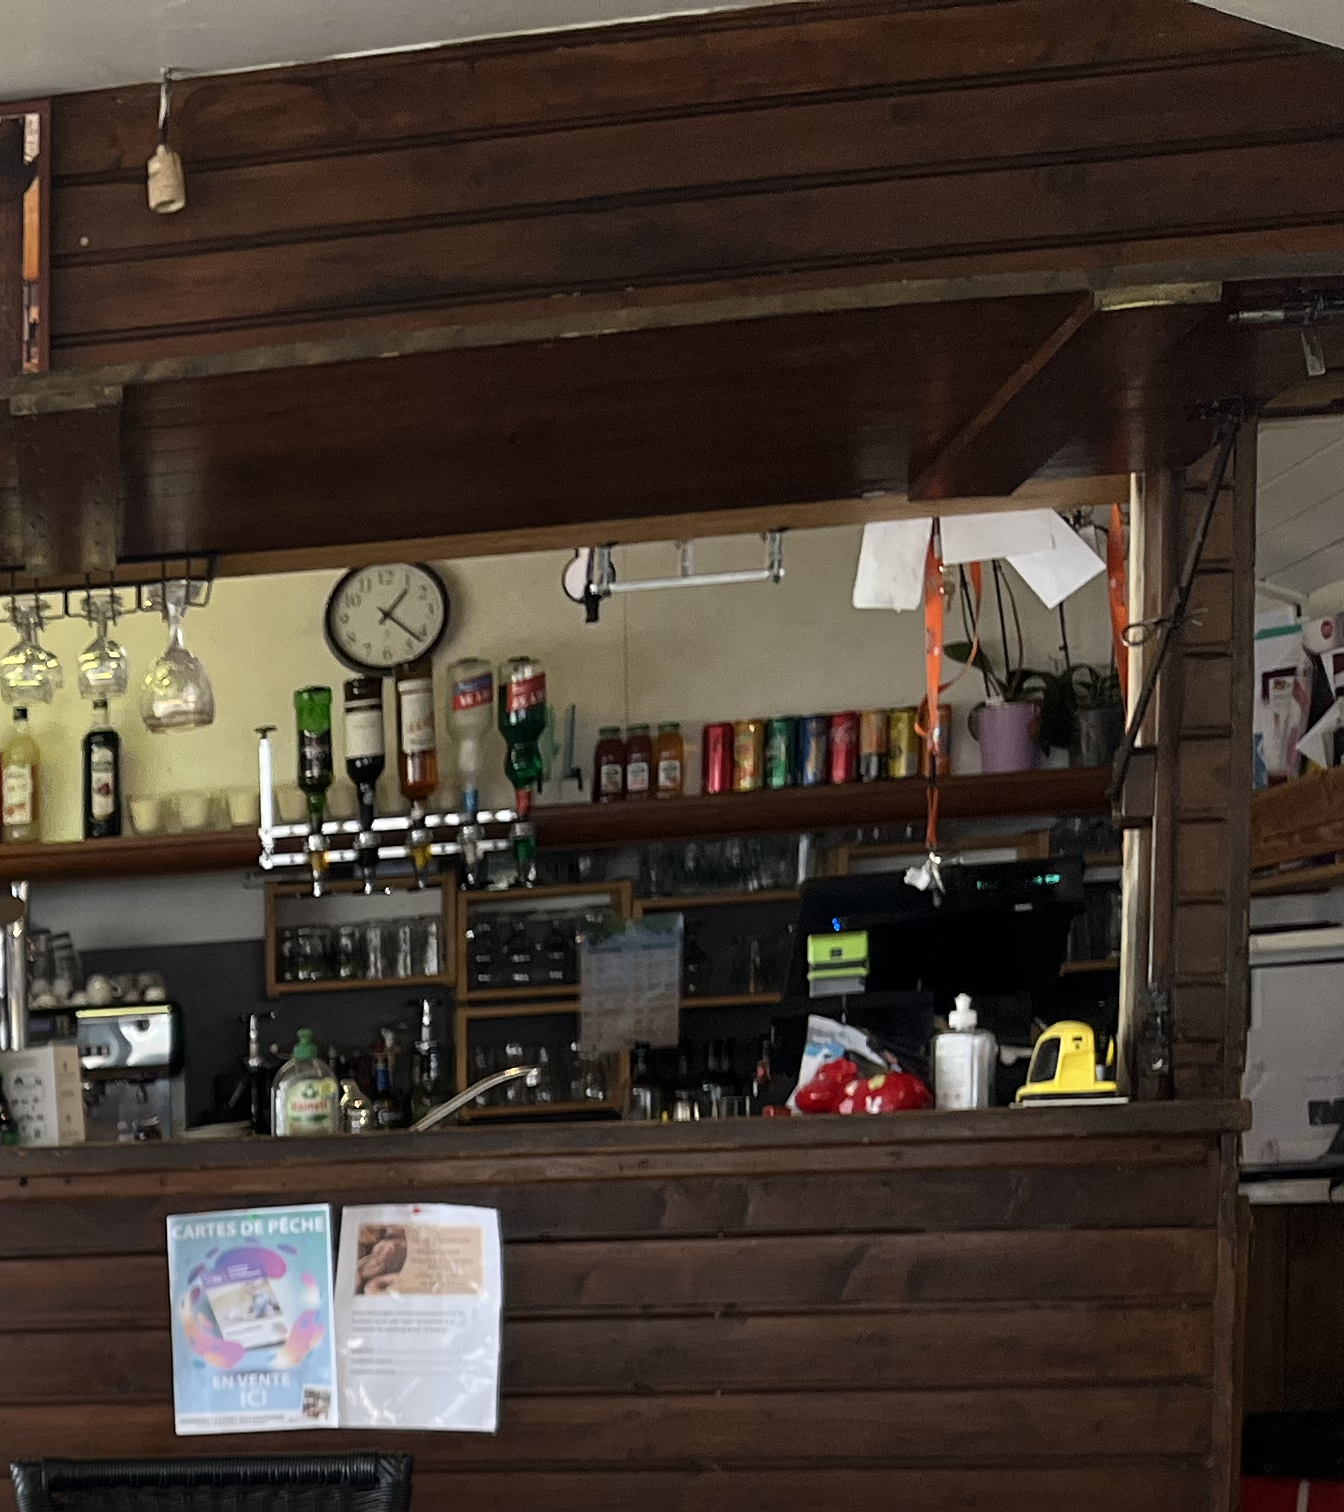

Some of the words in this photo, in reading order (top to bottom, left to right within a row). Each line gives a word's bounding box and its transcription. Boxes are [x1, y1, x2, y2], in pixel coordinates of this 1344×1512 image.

[172, 1221, 237, 1241] CARTES
[241, 1219, 264, 1236] DE
[212, 1374, 236, 1388] EN
[237, 1371, 291, 1388] VENTE
[240, 1390, 269, 1409] ICI
